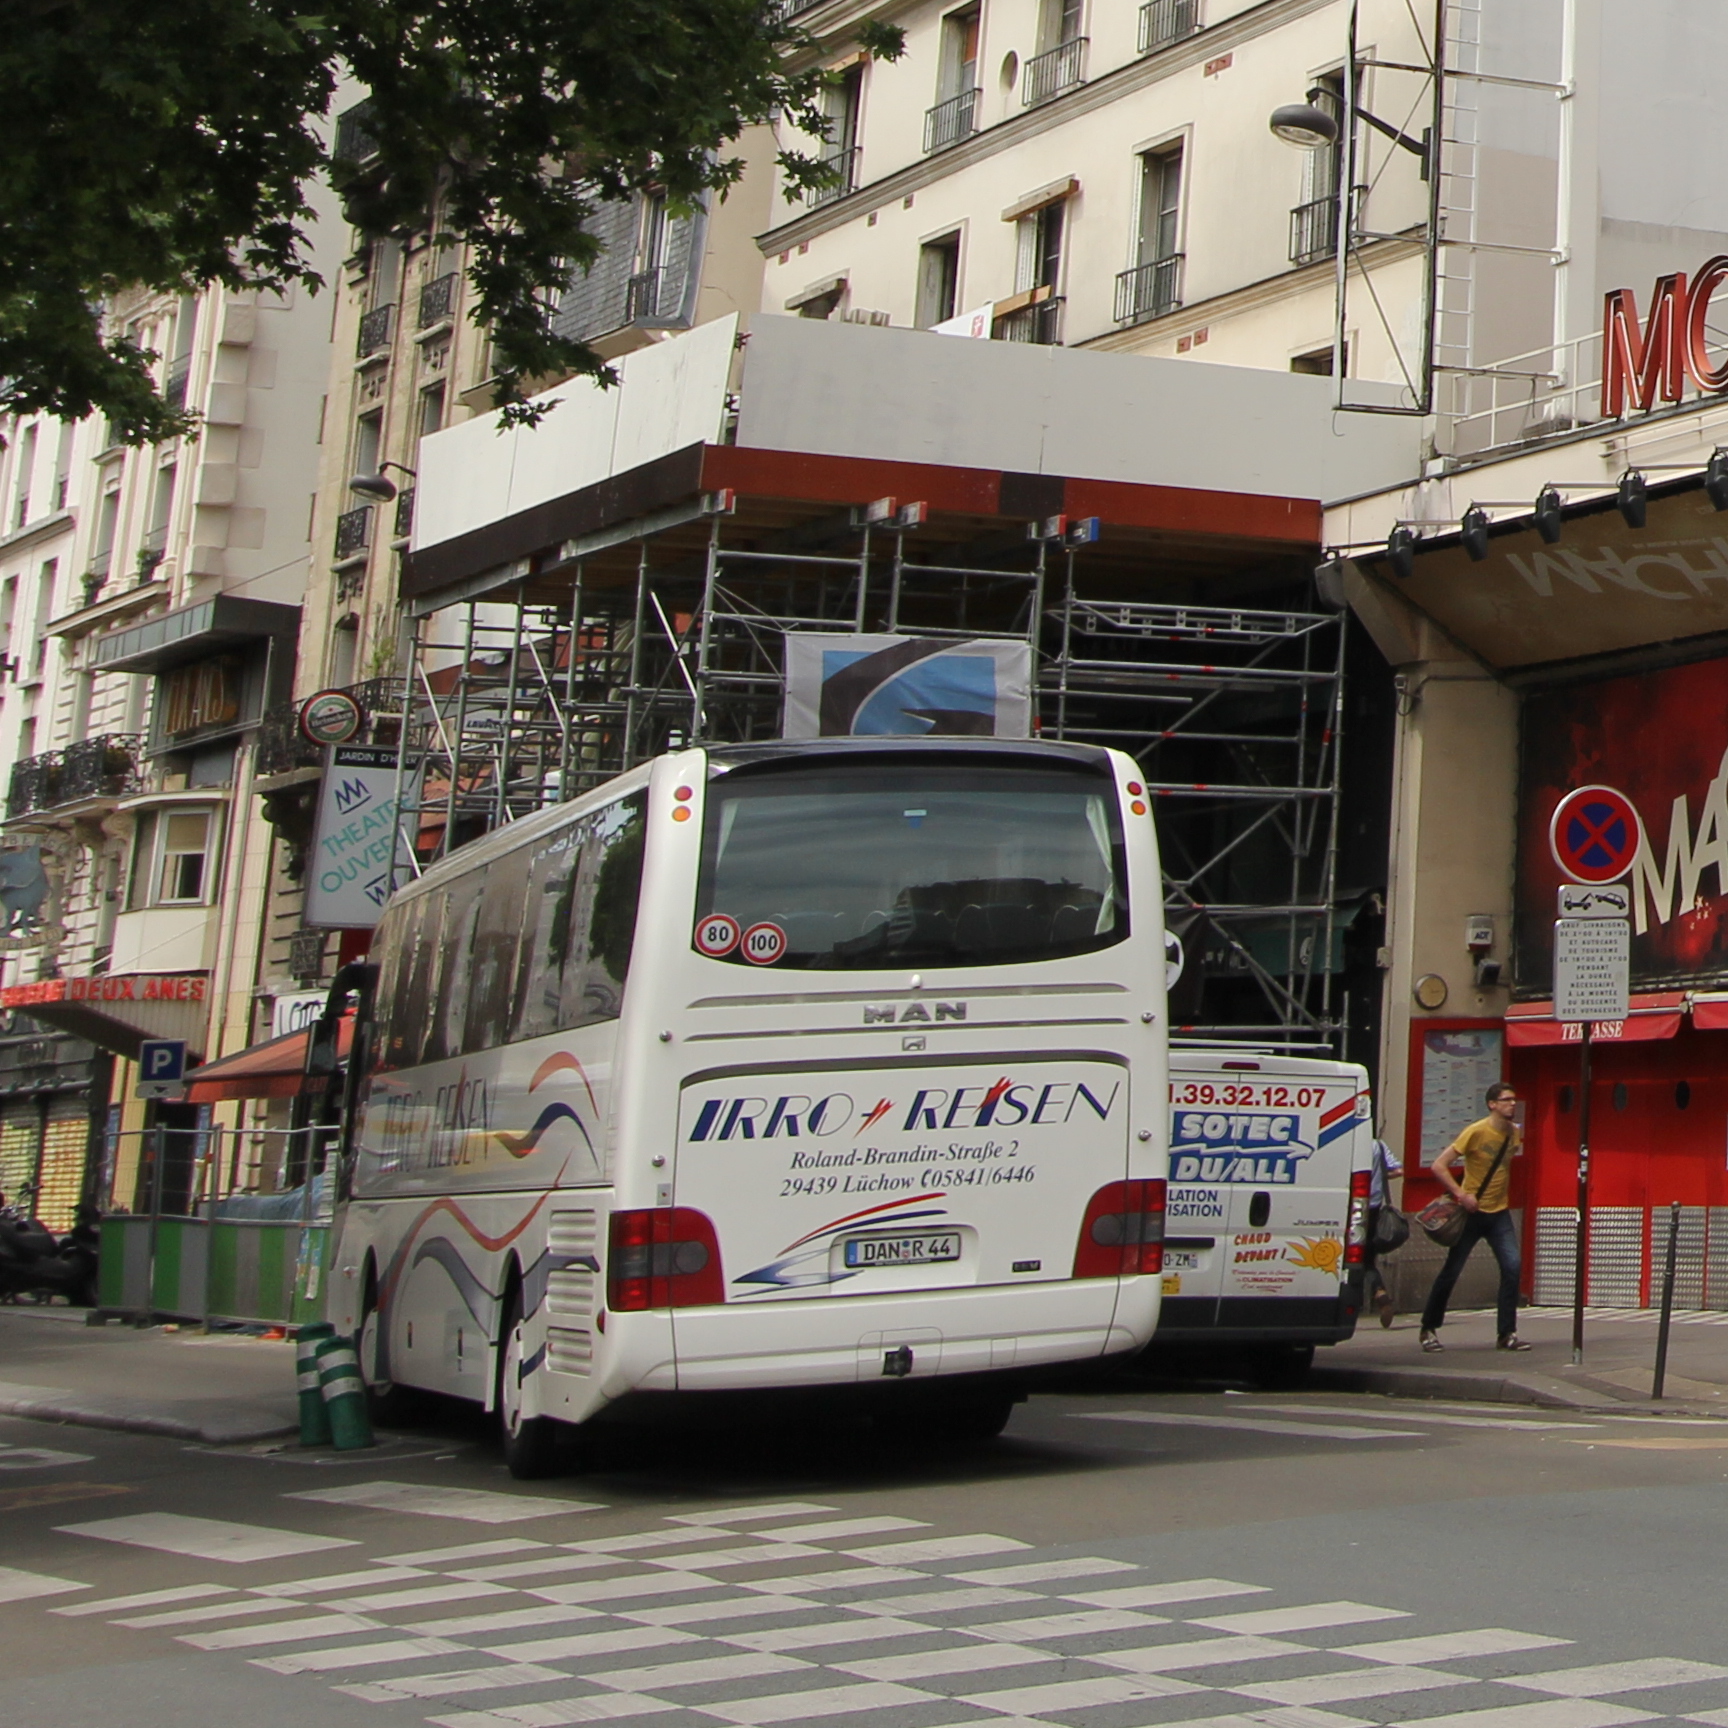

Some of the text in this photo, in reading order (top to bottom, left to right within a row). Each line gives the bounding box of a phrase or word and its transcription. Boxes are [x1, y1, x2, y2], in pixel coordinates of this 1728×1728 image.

[339, 752, 374, 762] JARDIN
[708, 926, 729, 942] 80
[750, 935, 777, 952] 100
[1474, 930, 1490, 942] ADT
[71, 977, 136, 1000] DEUX
[143, 977, 206, 1000] ANES
[863, 1002, 967, 1023] MAN
[1561, 1020, 1624, 1040] TERASSE
[152, 1049, 172, 1075] P
[688, 1077, 1121, 1142] IRRO REISEN
[1180, 1113, 1293, 1141] SOTEC
[790, 1140, 1019, 1171] Roland-Brandin-Straße 2
[1175, 1156, 1291, 1183] DU/ALL
[780, 1164, 1036, 1198] 29439 Lüchow 05841/6446
[1168, 1189, 1219, 1203] LATION
[1166, 1204, 1223, 1218] ISATION
[1293, 1219, 1340, 1227] JUMPER
[1233, 1232, 1272, 1246] CHAUD
[864, 1242, 900, 1262] DAN
[912, 1239, 923, 1257] R
[928, 1238, 951, 1256] 44
